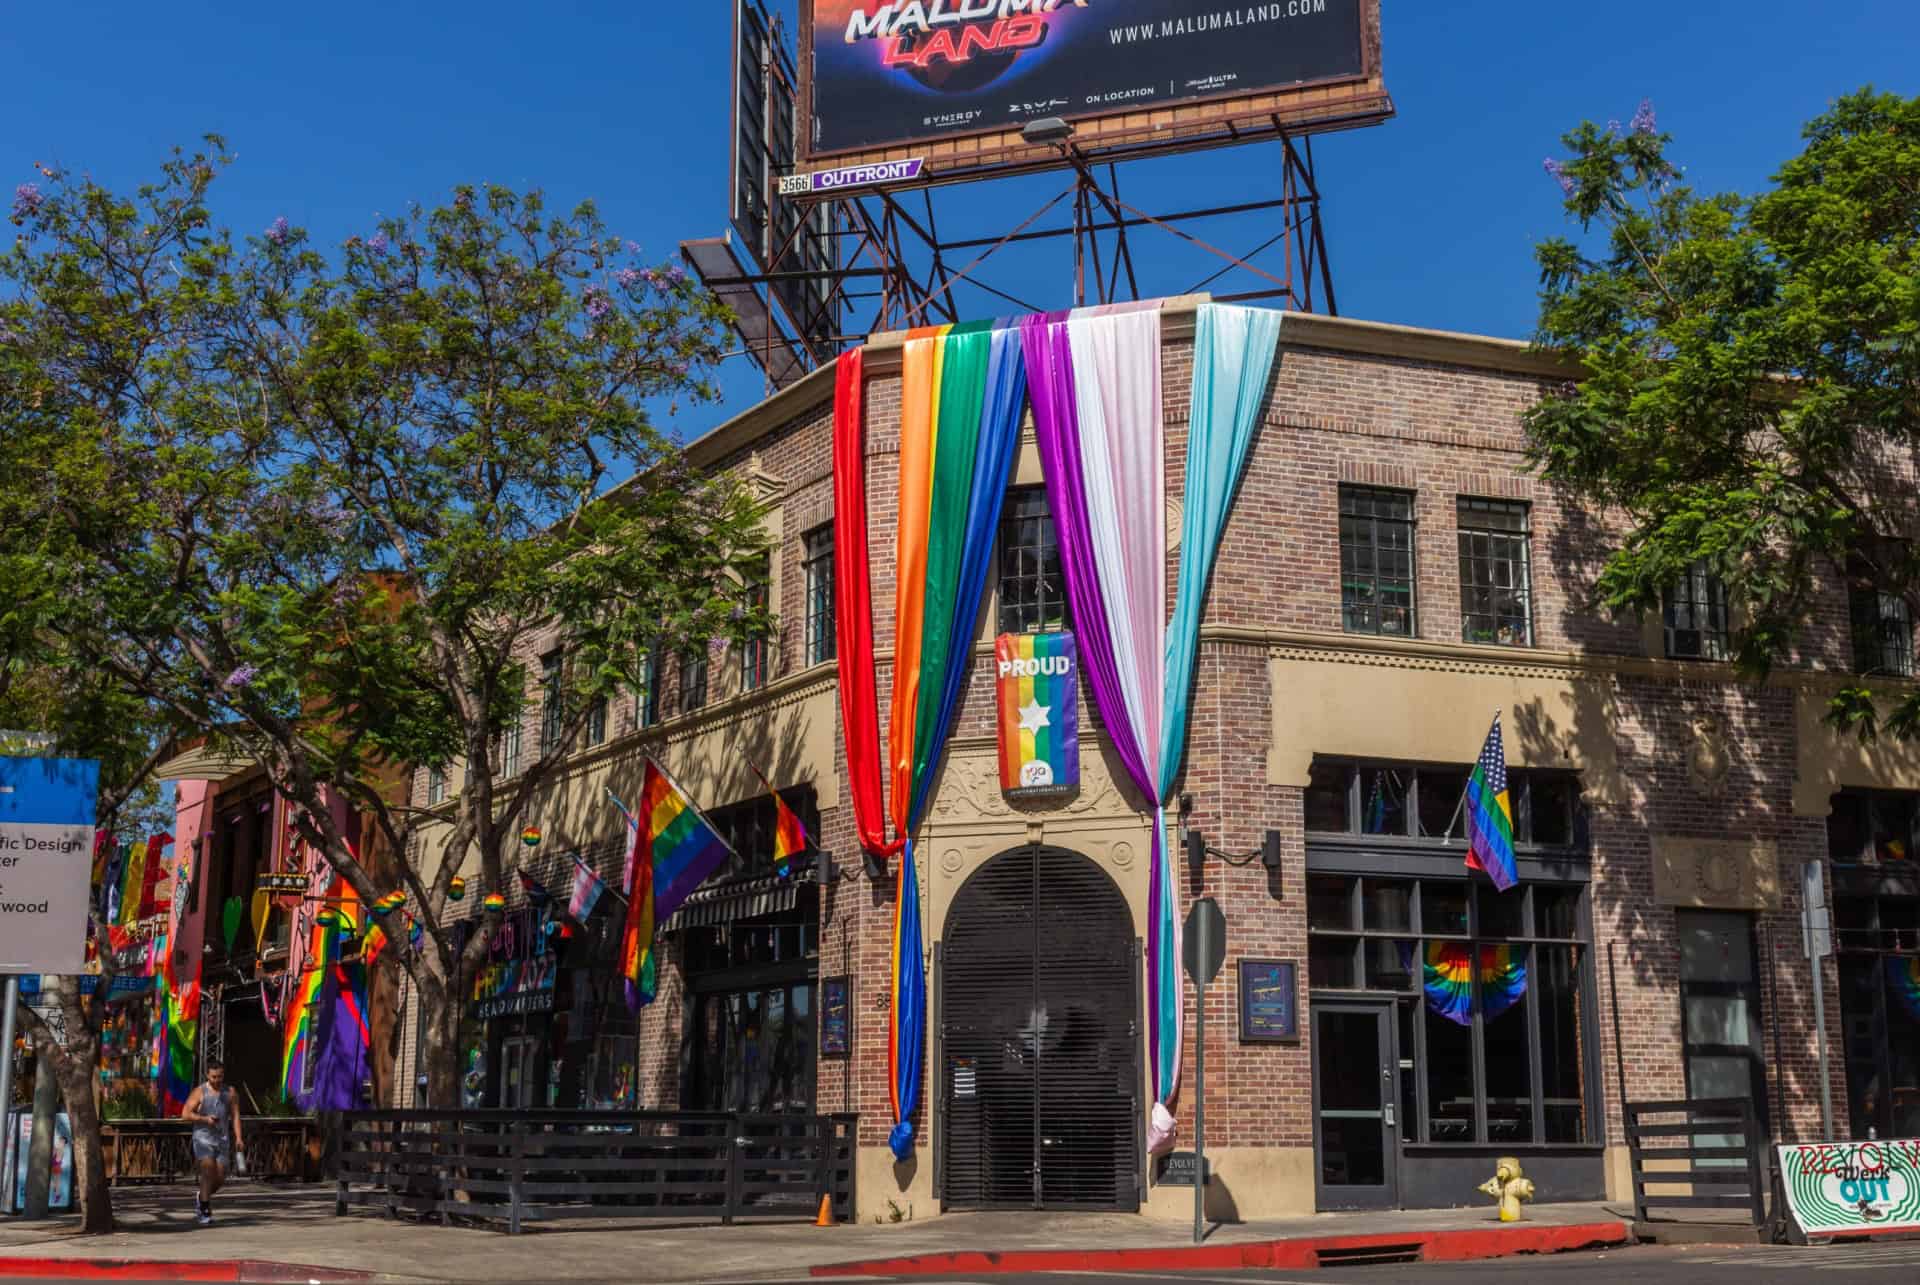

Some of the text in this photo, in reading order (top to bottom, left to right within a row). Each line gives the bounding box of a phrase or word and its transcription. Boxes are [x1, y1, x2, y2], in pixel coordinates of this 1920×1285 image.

[845, 0, 1088, 43] MALU
[1109, 0, 1326, 45] WWW.MALUMALAND.COM
[882, 14, 1043, 66] LAND
[1086, 87, 1155, 104] ON LOCATION
[923, 109, 982, 125] SYNERGY
[821, 162, 912, 186] OUTFRONT
[999, 656, 1070, 678] PROUD
[25, 837, 82, 853] Design
[1840, 1177, 1889, 1203] OUT
